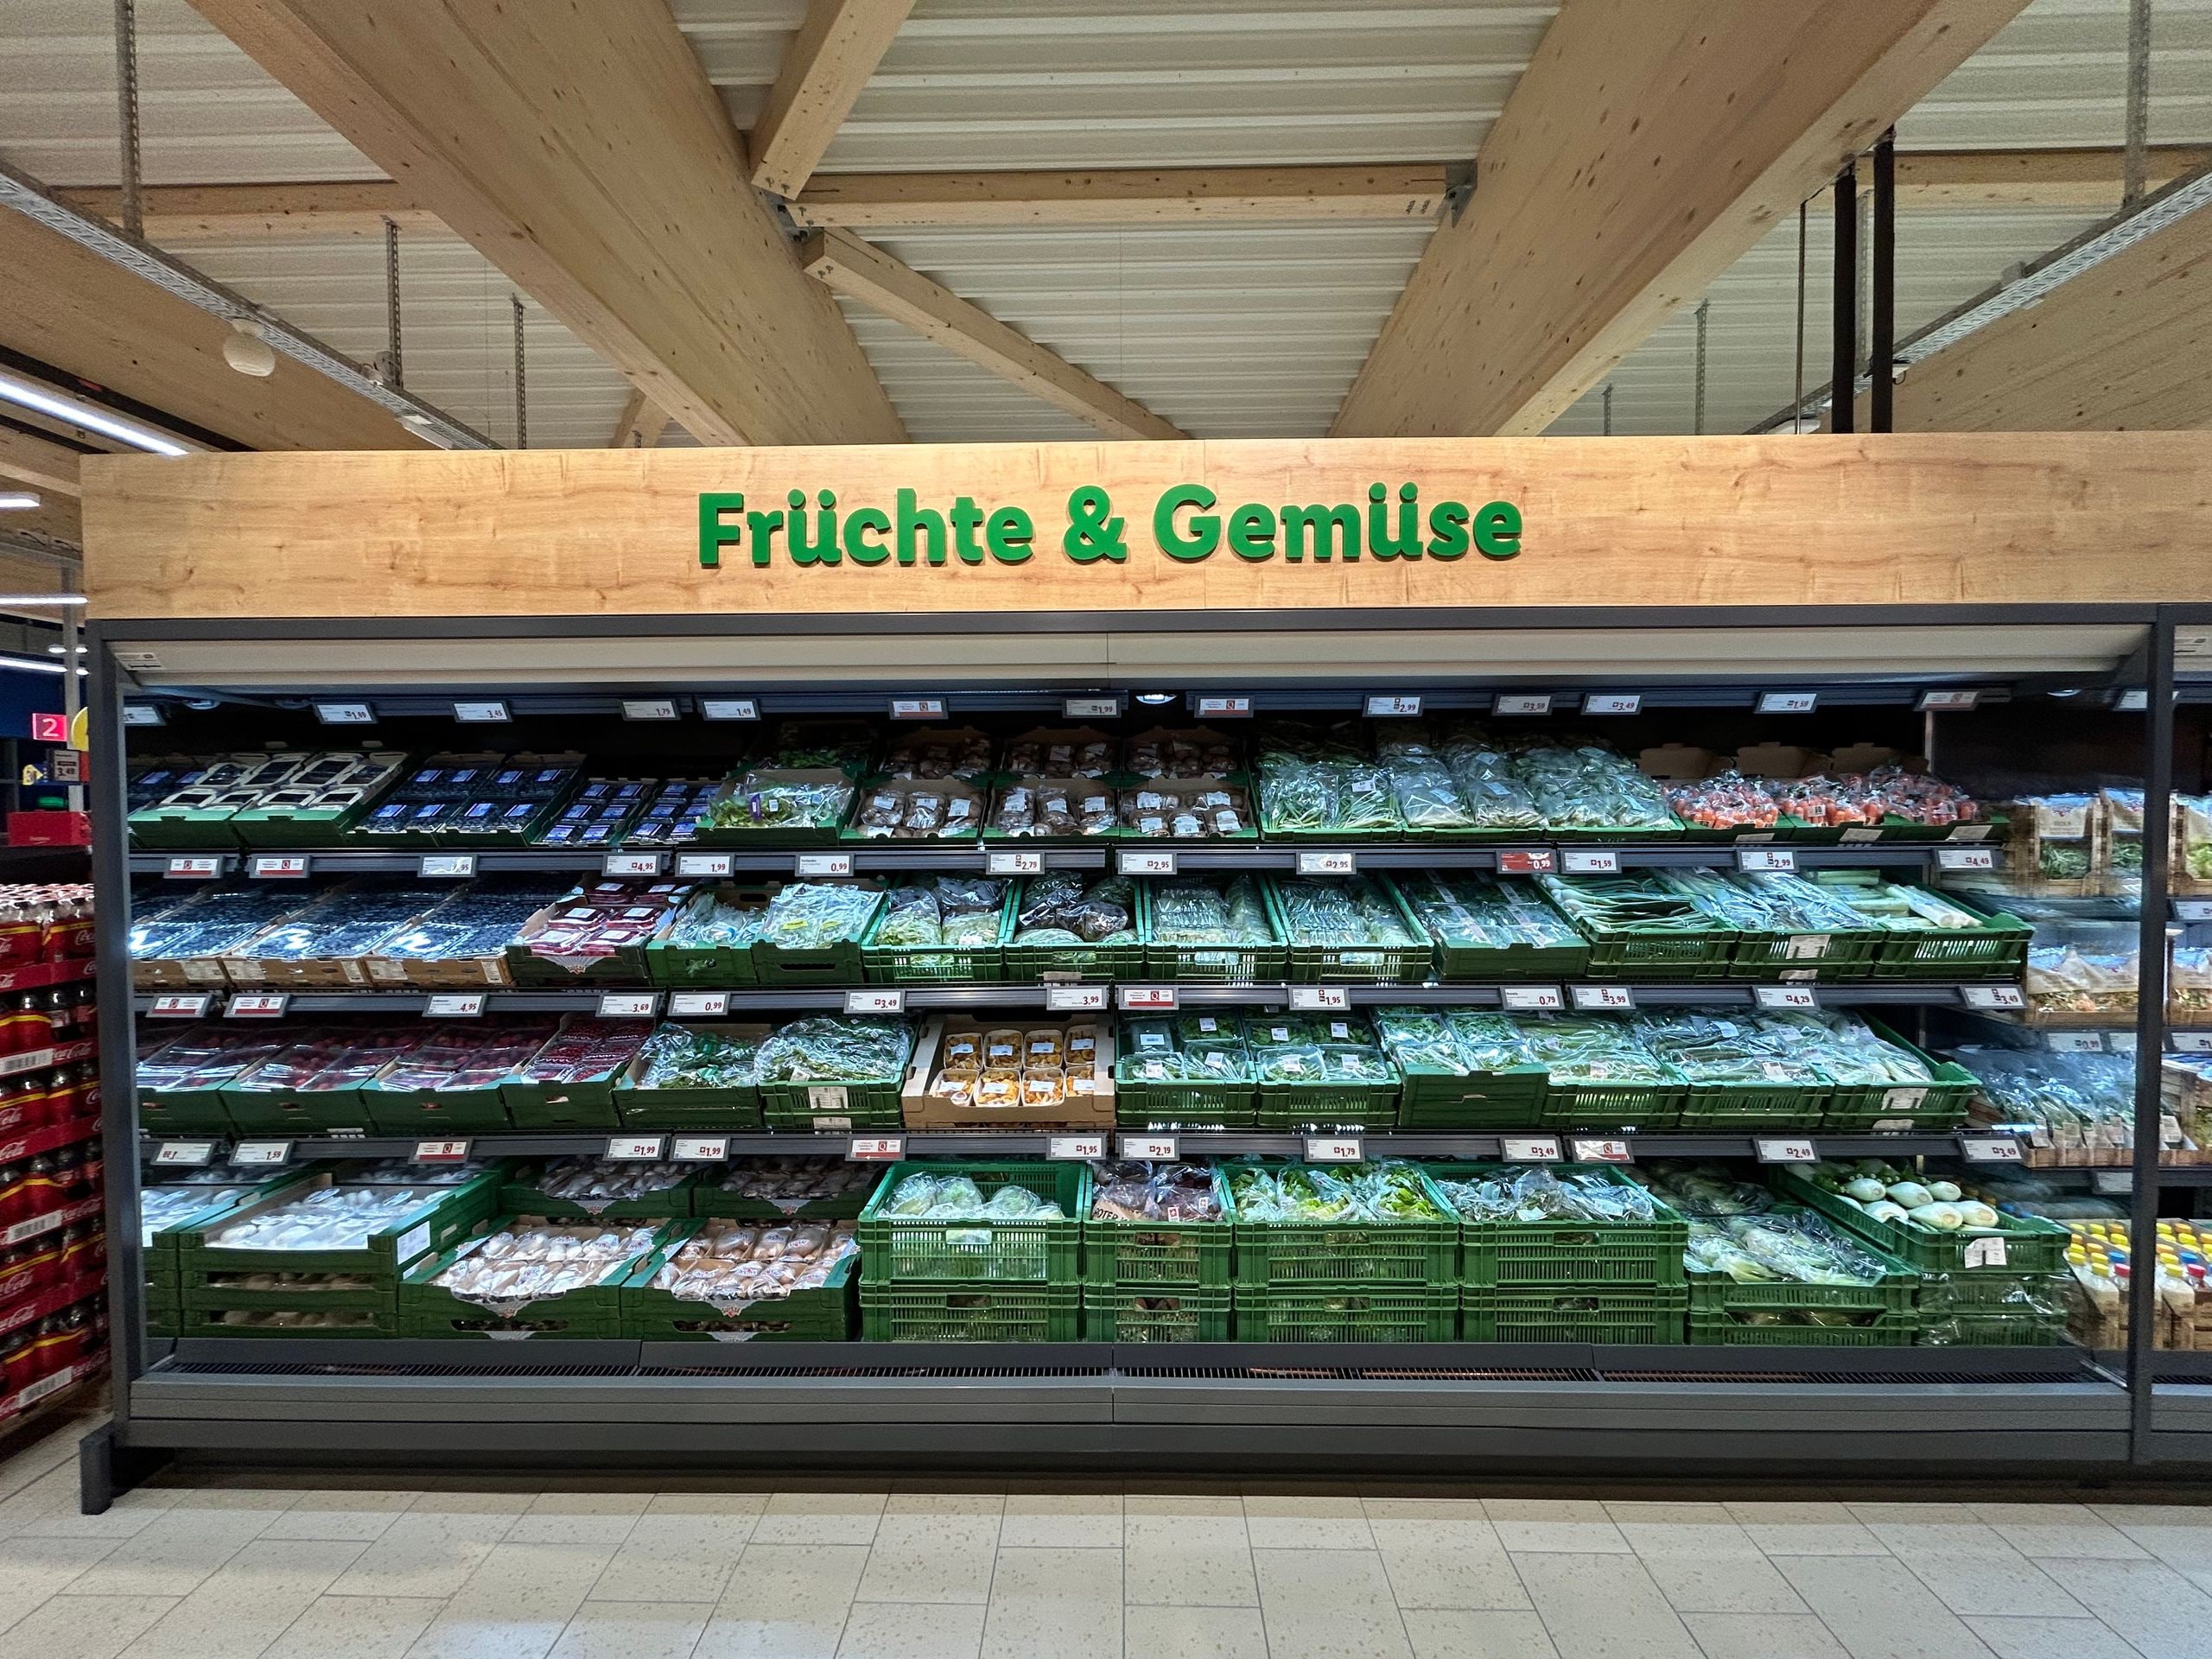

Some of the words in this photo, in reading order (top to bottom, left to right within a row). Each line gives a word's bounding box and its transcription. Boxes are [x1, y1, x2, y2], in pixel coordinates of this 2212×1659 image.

[700, 490, 1033, 565] Früchte
[1065, 487, 1127, 562] &
[1156, 483, 1522, 562] Gemüse
[1618, 702, 1635, 710] 3.49
[487, 710, 502, 719] 3.45
[42, 718, 58, 736] 2
[831, 863, 848, 872] 0.99
[1534, 860, 1550, 869] 0.99
[1598, 860, 1611, 868] 1.59
[1774, 859, 1790, 868] 2.99
[454, 864, 468, 873] .95
[711, 864, 726, 873] 1.99
[880, 1000, 897, 1008] 3.49
[1083, 996, 1099, 1005] 3.99
[1325, 996, 1340, 1005] 1.95
[1539, 996, 1555, 1005] 0.79
[1610, 995, 1626, 1004] 3.99
[1793, 995, 1810, 1004] 4.29
[460, 1003, 476, 1012] 4.95
[632, 1003, 649, 1012] 3.69
[705, 1002, 721, 1011] 0.99
[640, 1147, 655, 1156] 1.99
[705, 1147, 721, 1156] 1.99
[1083, 1146, 1097, 1154] 1.95
[1155, 1146, 1171, 1155] 2.19
[1340, 1147, 1355, 1157] 1.79
[1539, 1147, 1554, 1157] 3.49
[1794, 1148, 1810, 1158] 2.49
